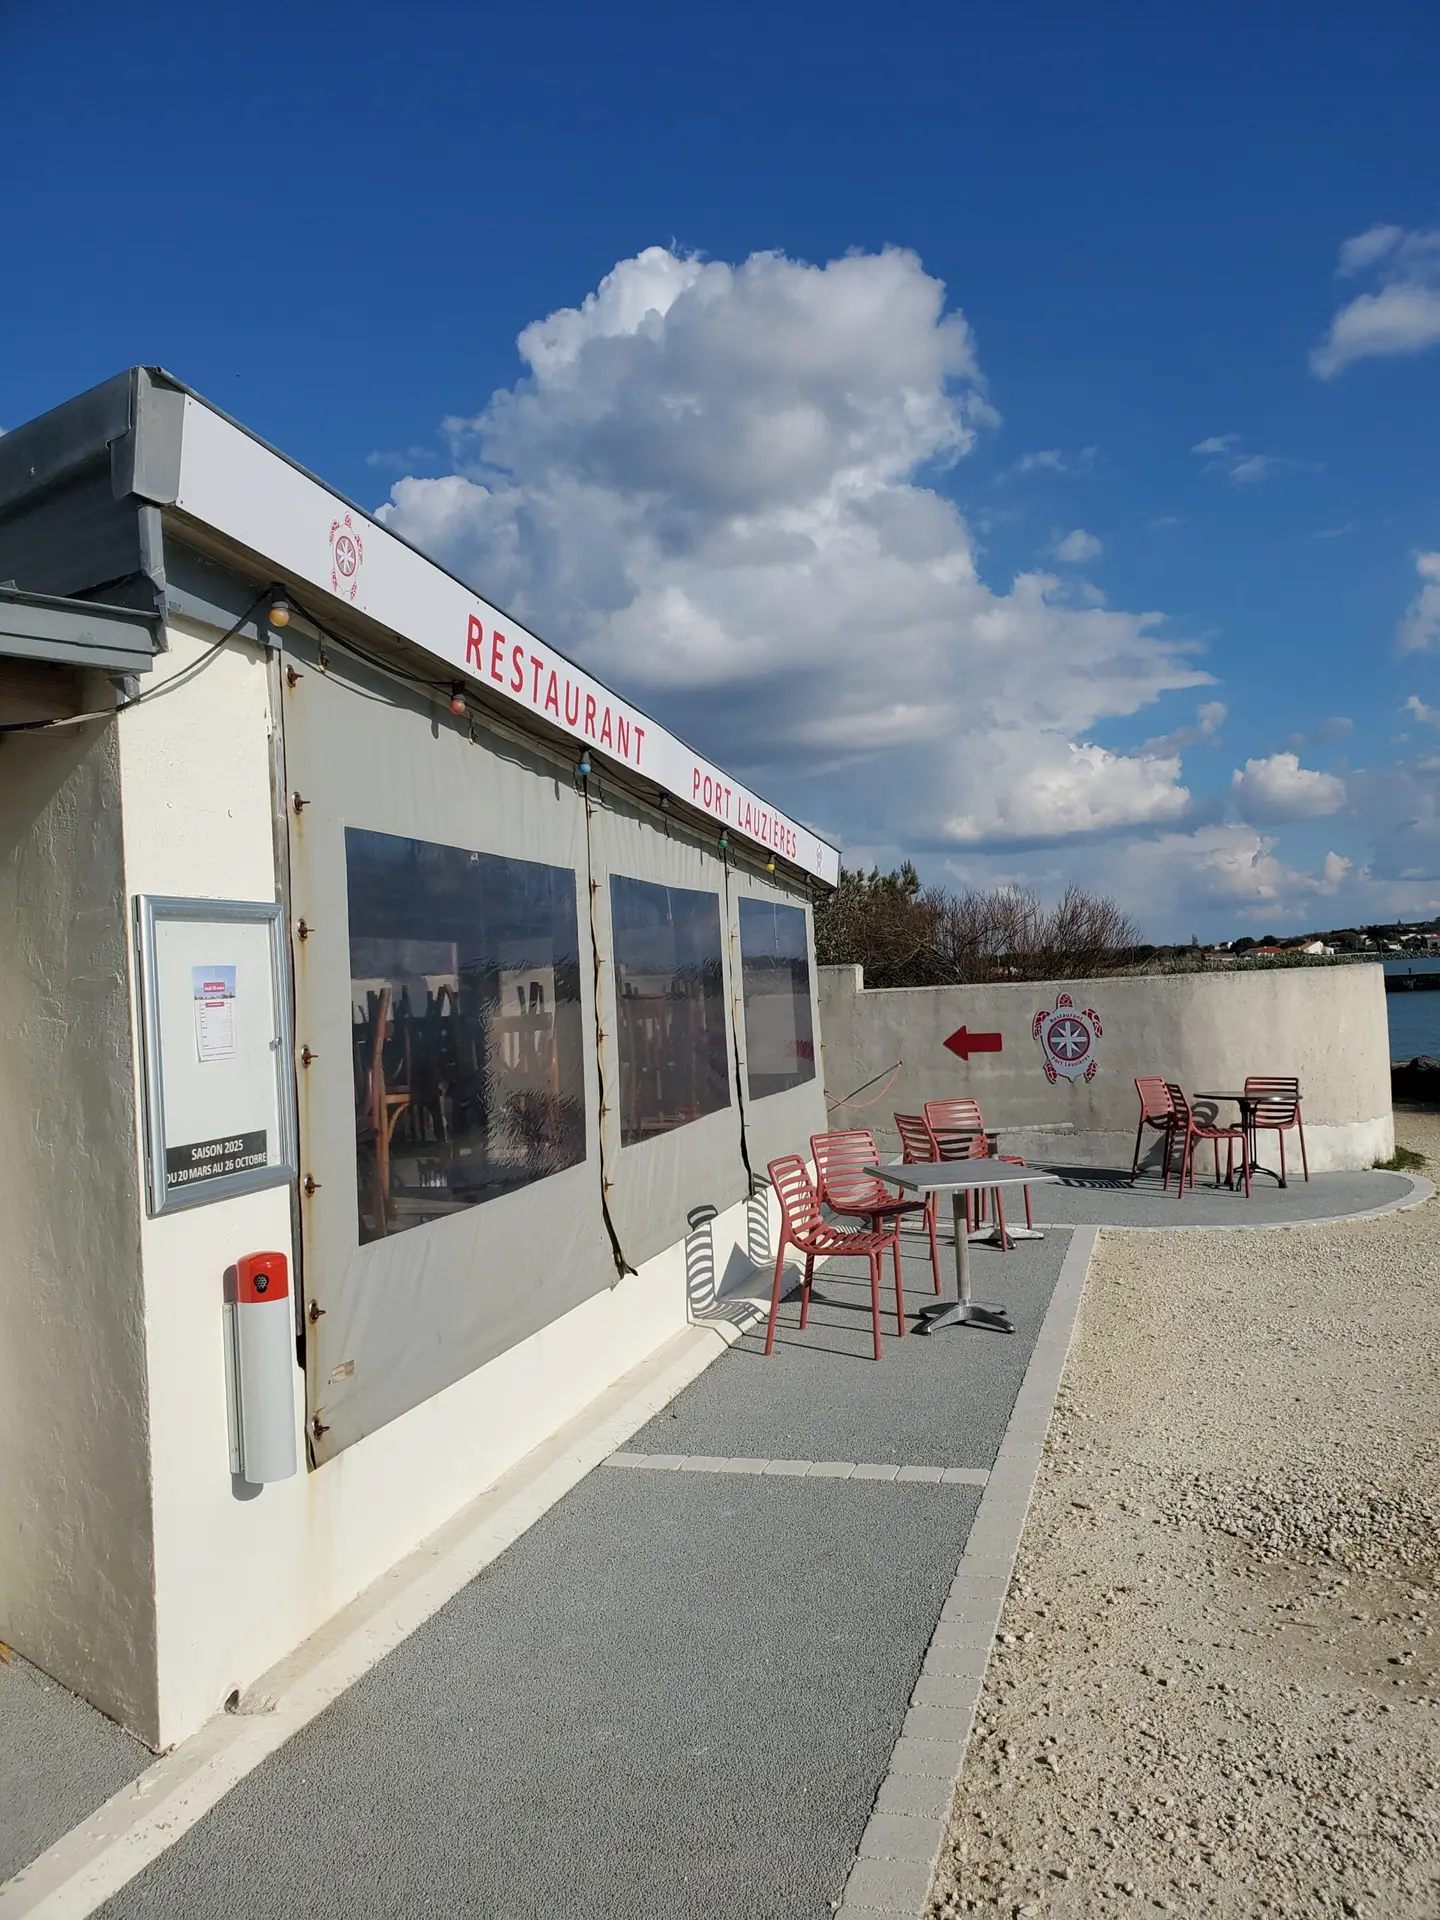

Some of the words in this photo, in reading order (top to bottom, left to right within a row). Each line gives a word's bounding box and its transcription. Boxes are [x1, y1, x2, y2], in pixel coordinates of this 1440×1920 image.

[466, 614, 645, 765] RESTAURANT
[693, 768, 731, 819] PORT
[738, 797, 797, 858] LAUZIÈRES
[1050, 1013, 1083, 1023] Restaurant
[191, 1145, 223, 1160] SAISON
[224, 1140, 243, 1154] 2025
[178, 1169, 188, 1182] 20
[189, 1165, 212, 1179] MARS
[212, 1161, 224, 1173] AU
[225, 1159, 234, 1171] 26
[235, 1152, 267, 1168] OCTOBRE
